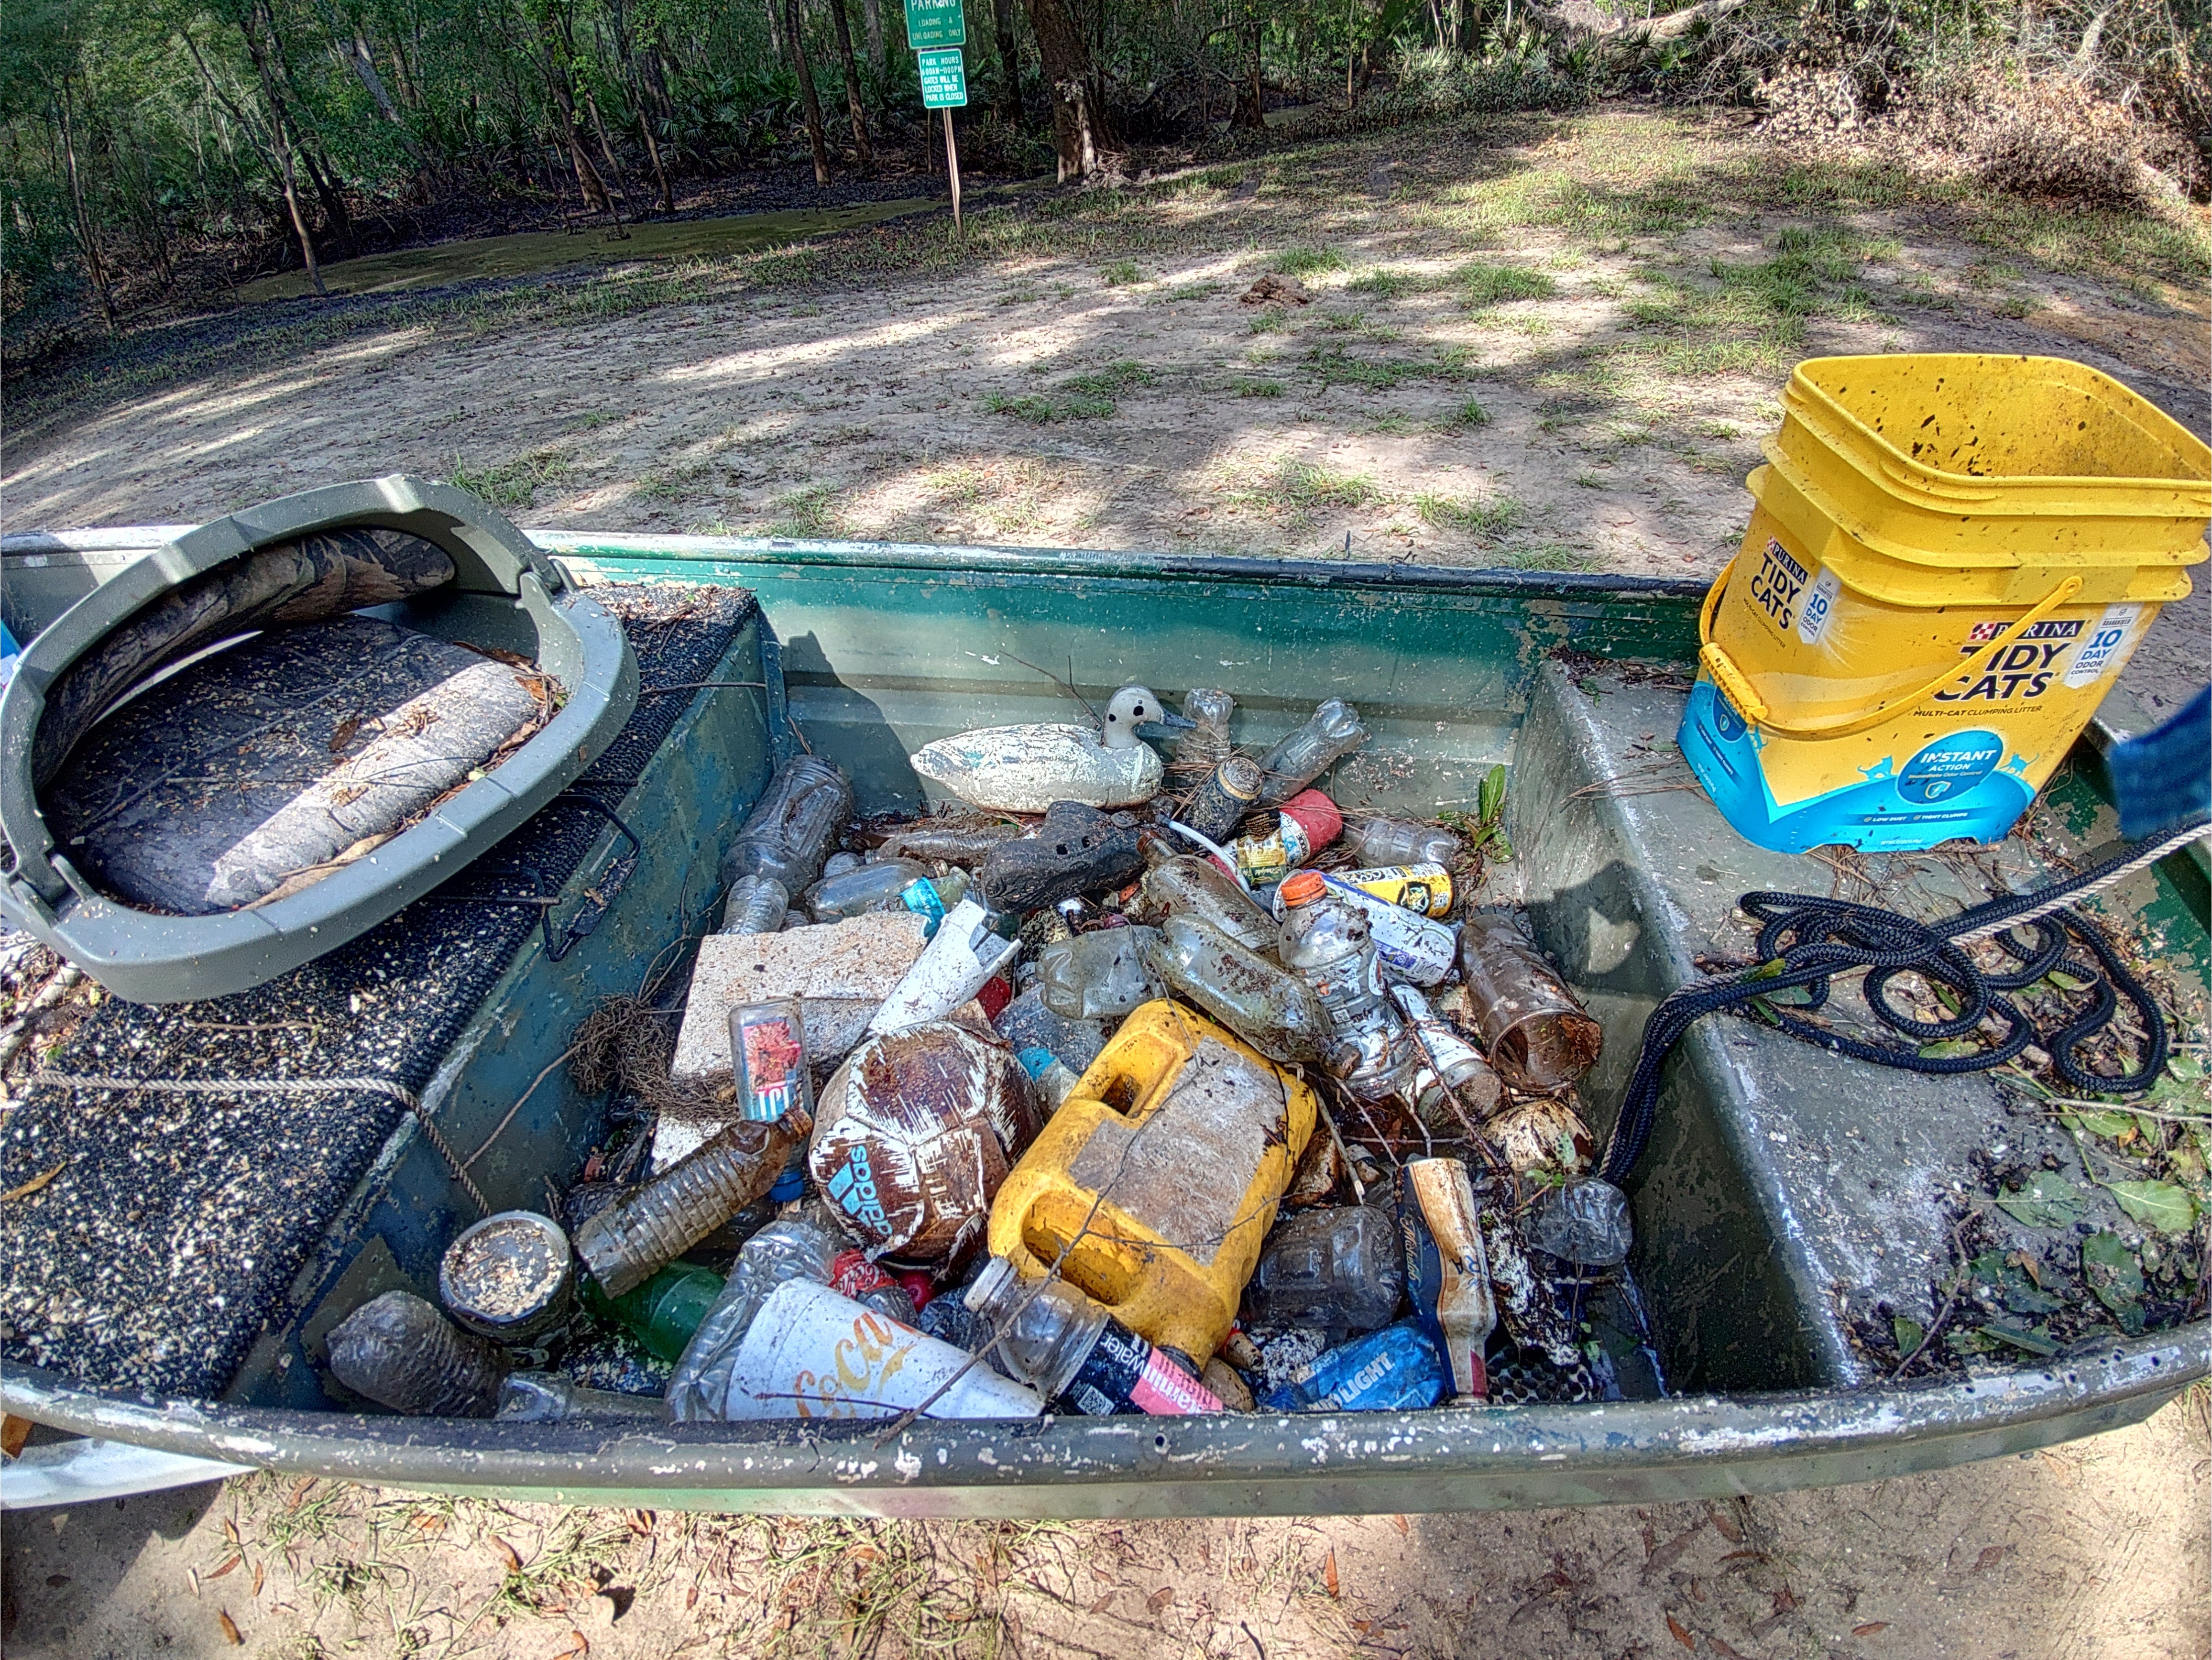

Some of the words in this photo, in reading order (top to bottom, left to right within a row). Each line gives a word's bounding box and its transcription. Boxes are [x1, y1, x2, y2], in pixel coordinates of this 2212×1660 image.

[918, 18, 941, 27] LOADING
[912, 31, 942, 40] UNLOADING
[948, 29, 961, 37] ONLY
[922, 58, 937, 66] PARK
[941, 56, 959, 65] HOURS
[924, 76, 938, 85] GATES
[925, 85, 942, 93] LOCKED
[1773, 544, 1805, 584] PURINA
[1761, 551, 1801, 604] TIDY
[1751, 575, 1793, 630] CATS
[1810, 593, 1828, 615] 10
[1806, 607, 1823, 625] DAY
[1803, 616, 1818, 632] ODOR
[1993, 622, 2077, 638] PRINA
[1773, 635, 1786, 649] LITTER
[2088, 629, 2123, 649] 10
[2081, 649, 2112, 660] DAY
[2075, 660, 2104, 669] ODOR
[1913, 709, 1967, 717] MULTI-CAT
[1967, 707, 2013, 716] CLUMPING
[2014, 705, 2043, 714] LITTER
[1919, 749, 1997, 764] INSTANT
[1928, 763, 1971, 772] ACTION
[850, 1145, 893, 1235] adidas
[1399, 1217, 1422, 1282] Michelob
[1338, 1351, 1393, 1403] LIGHT
